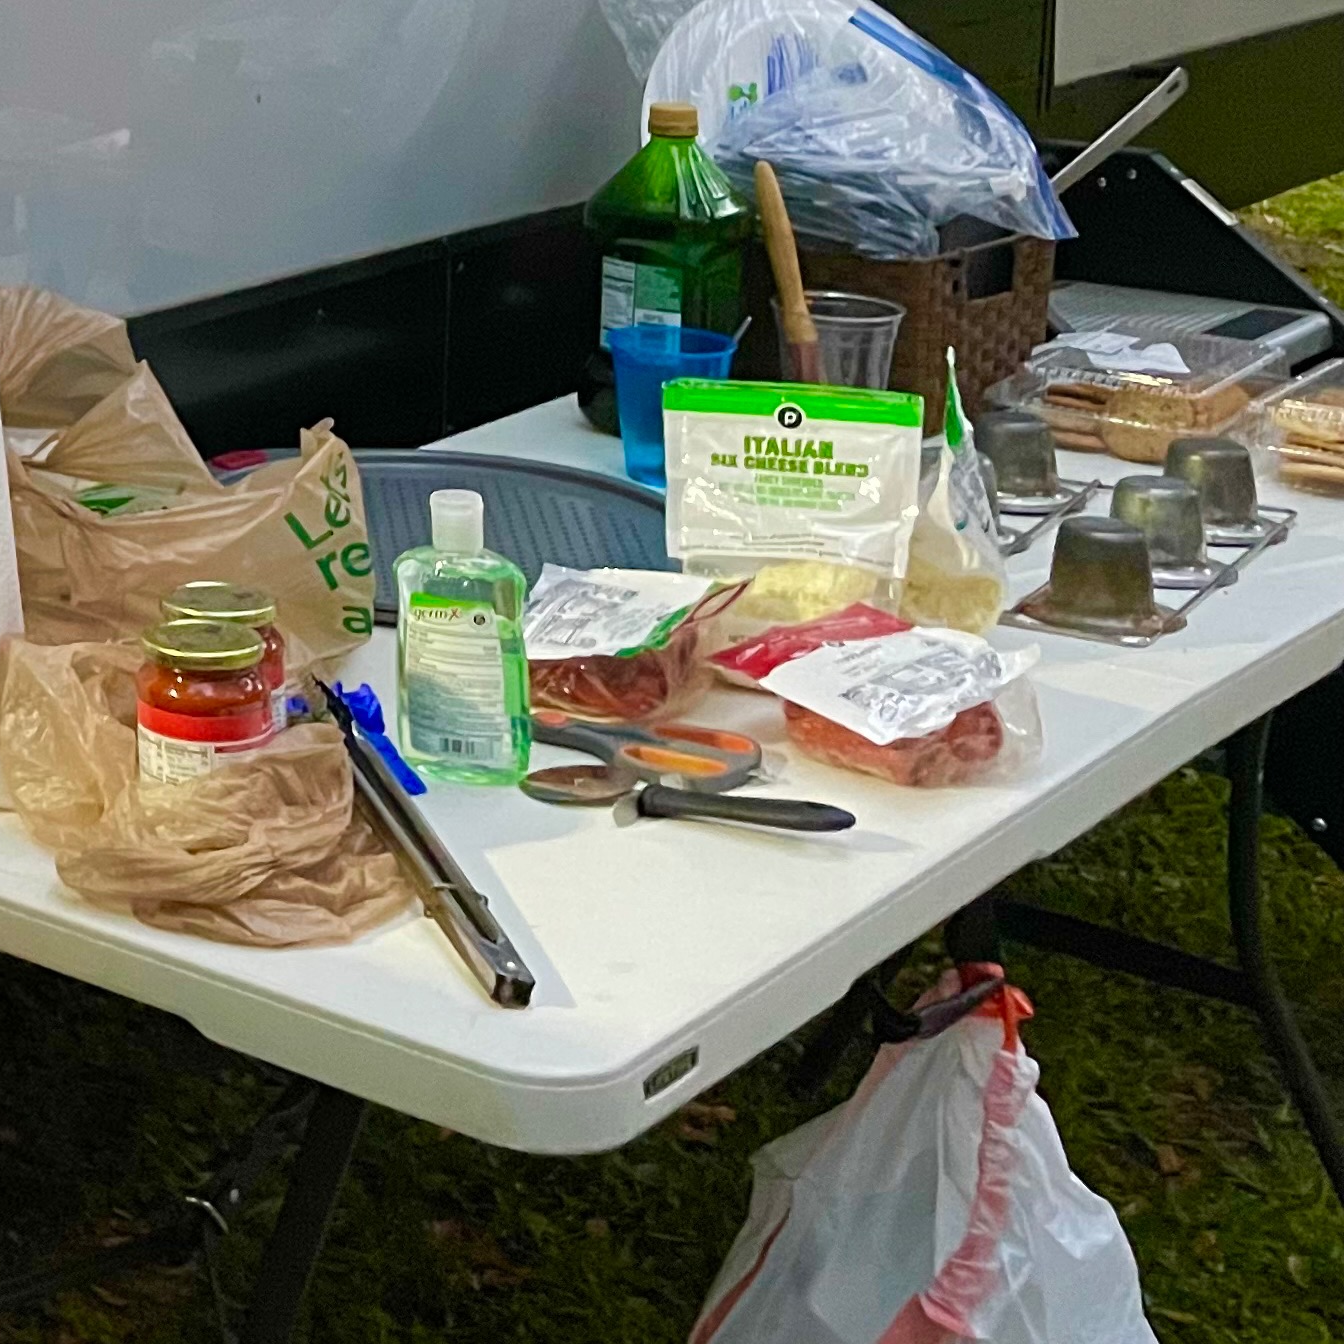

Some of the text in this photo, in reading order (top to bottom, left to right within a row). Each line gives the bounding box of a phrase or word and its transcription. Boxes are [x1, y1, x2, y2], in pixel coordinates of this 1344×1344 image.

[743, 435, 834, 460] ITALIAN
[711, 452, 870, 478] SIX CHEESE BLEND
